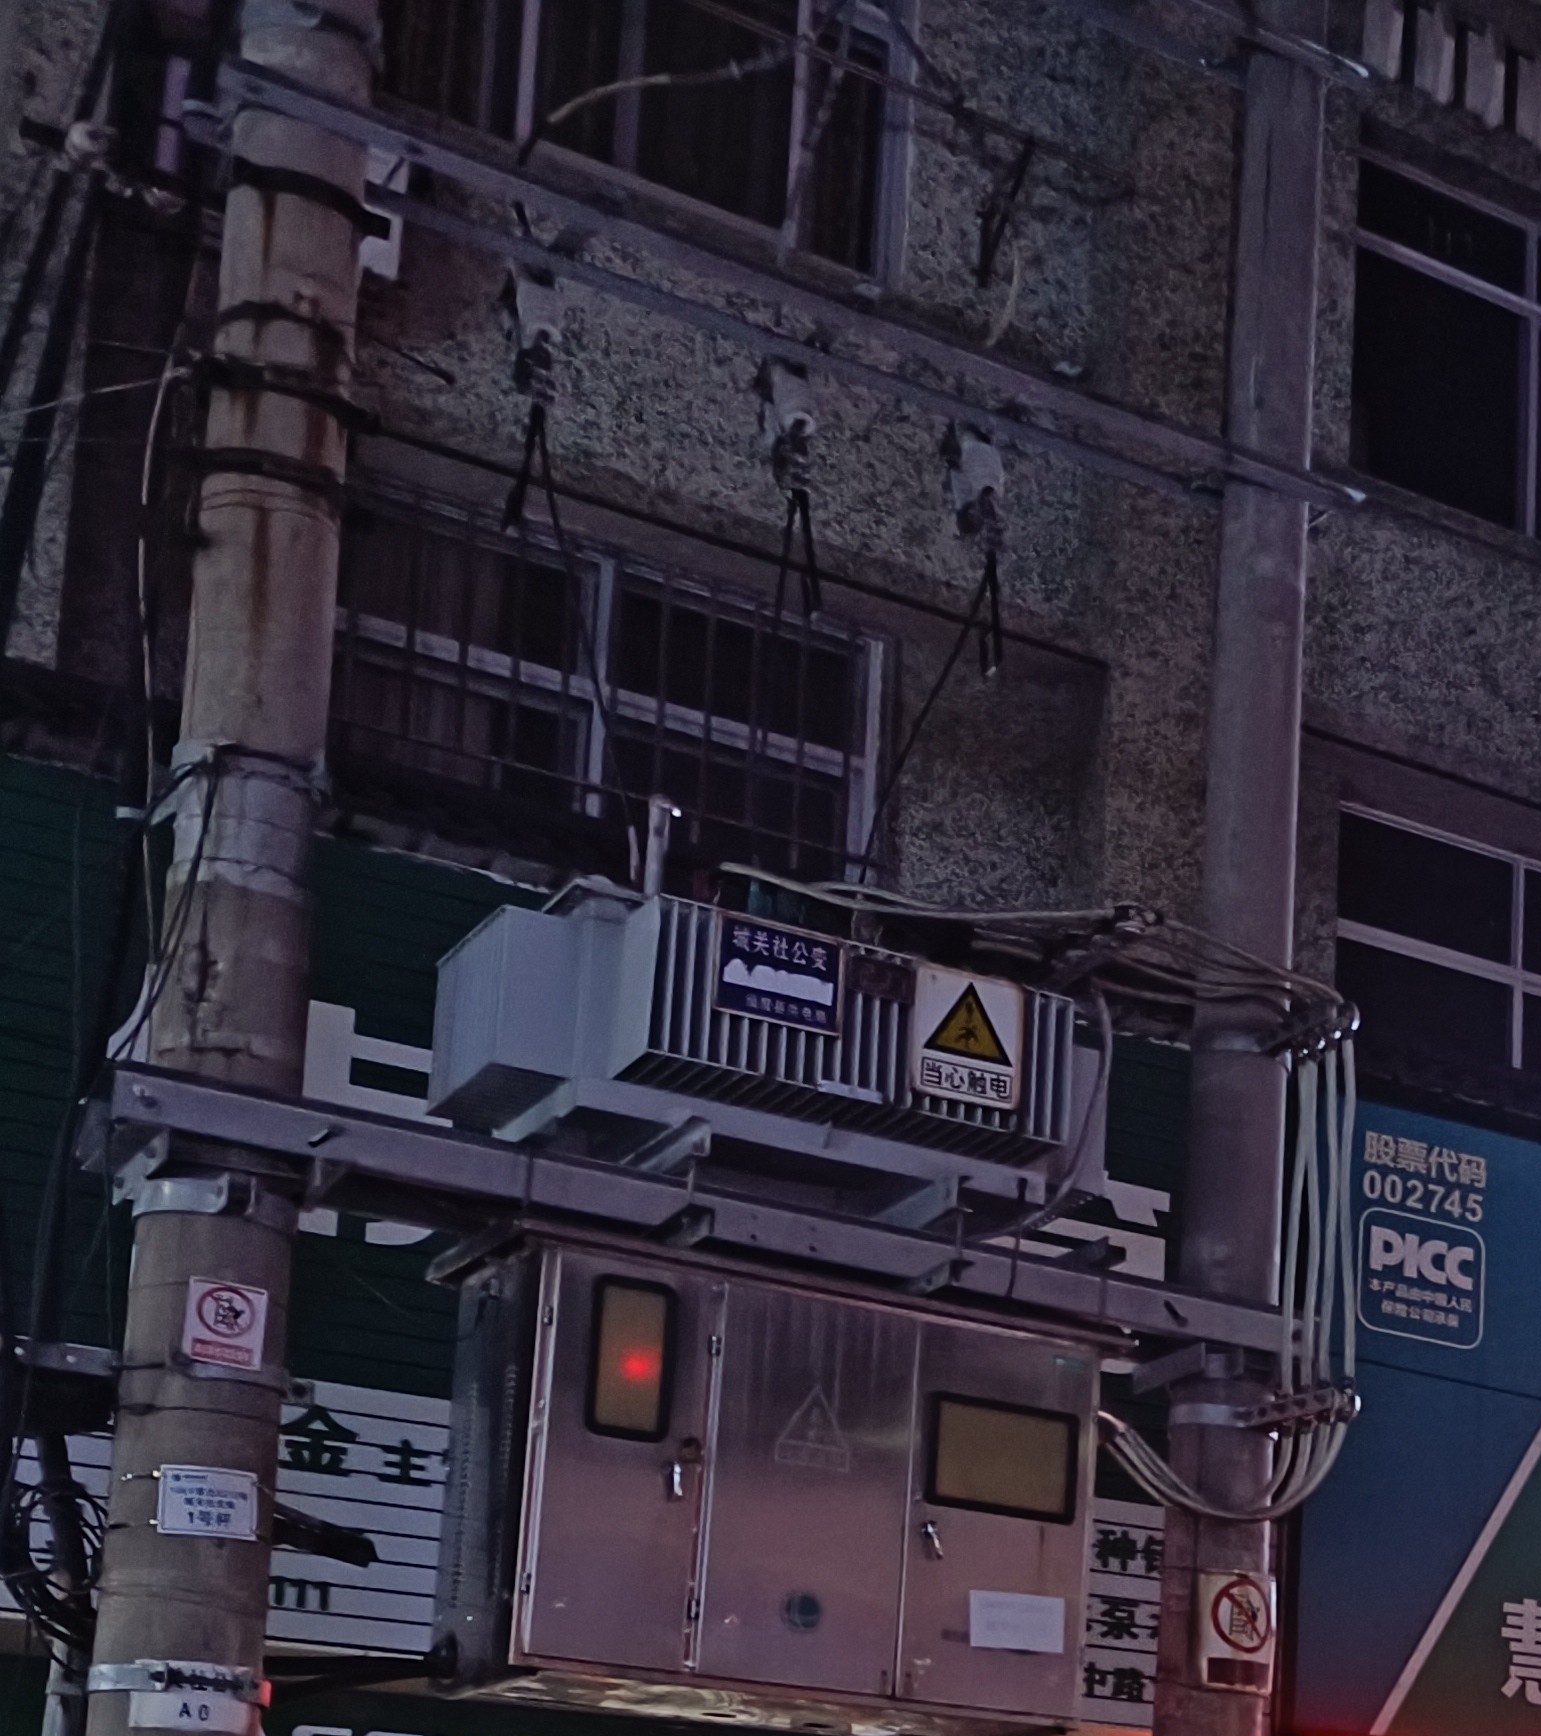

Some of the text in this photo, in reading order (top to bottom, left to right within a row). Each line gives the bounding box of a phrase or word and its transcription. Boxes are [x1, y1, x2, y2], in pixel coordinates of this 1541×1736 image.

[924, 1061, 1008, 1099] 当心触电
[1363, 1130, 1487, 1189] 股票代码
[1362, 1169, 1484, 1223] 002745
[1368, 1225, 1475, 1291] PICC
